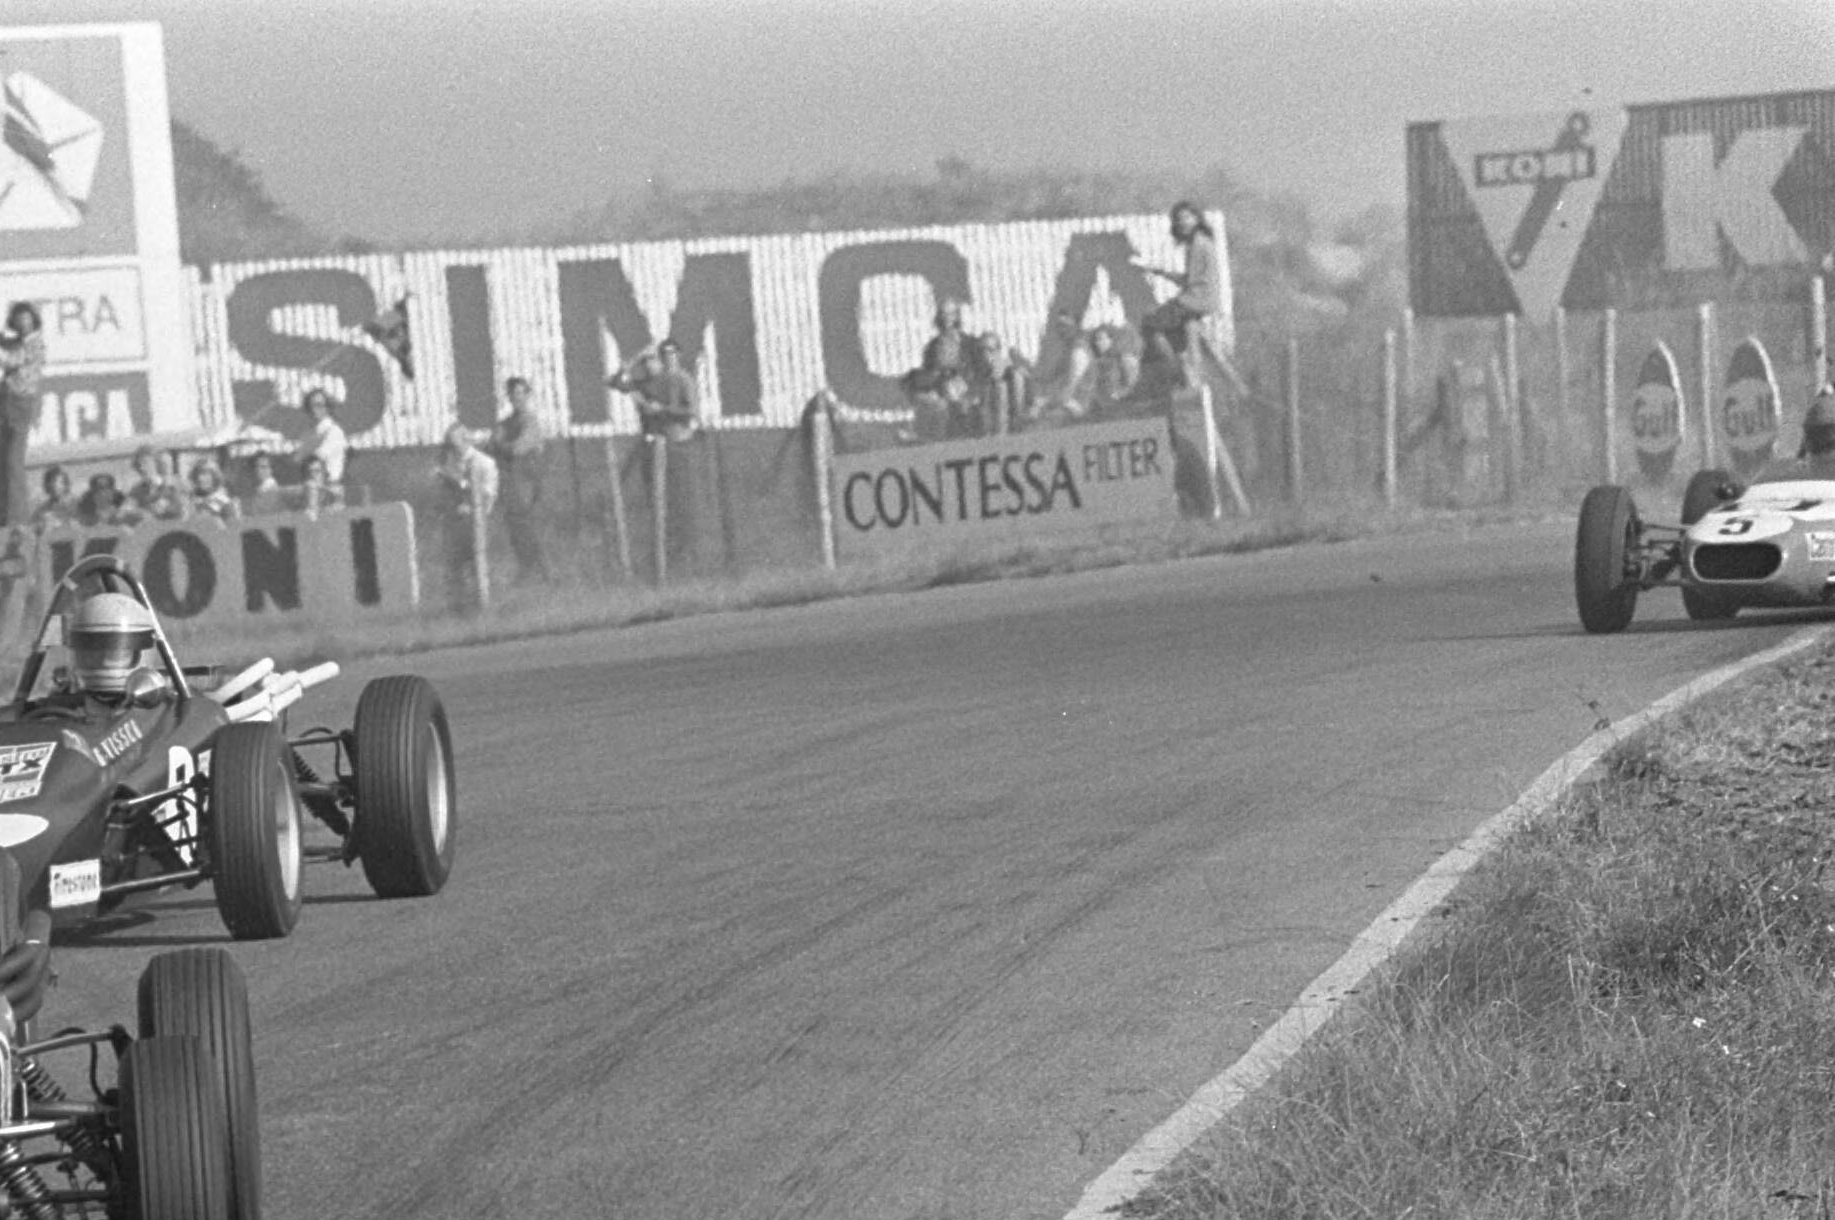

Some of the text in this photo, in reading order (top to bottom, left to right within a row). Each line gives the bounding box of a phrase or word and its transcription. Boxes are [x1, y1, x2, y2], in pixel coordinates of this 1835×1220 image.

[1479, 150, 1591, 184] KONI
[227, 231, 1179, 440] SIMCA
[844, 437, 1162, 531] CONTESSA FILTER
